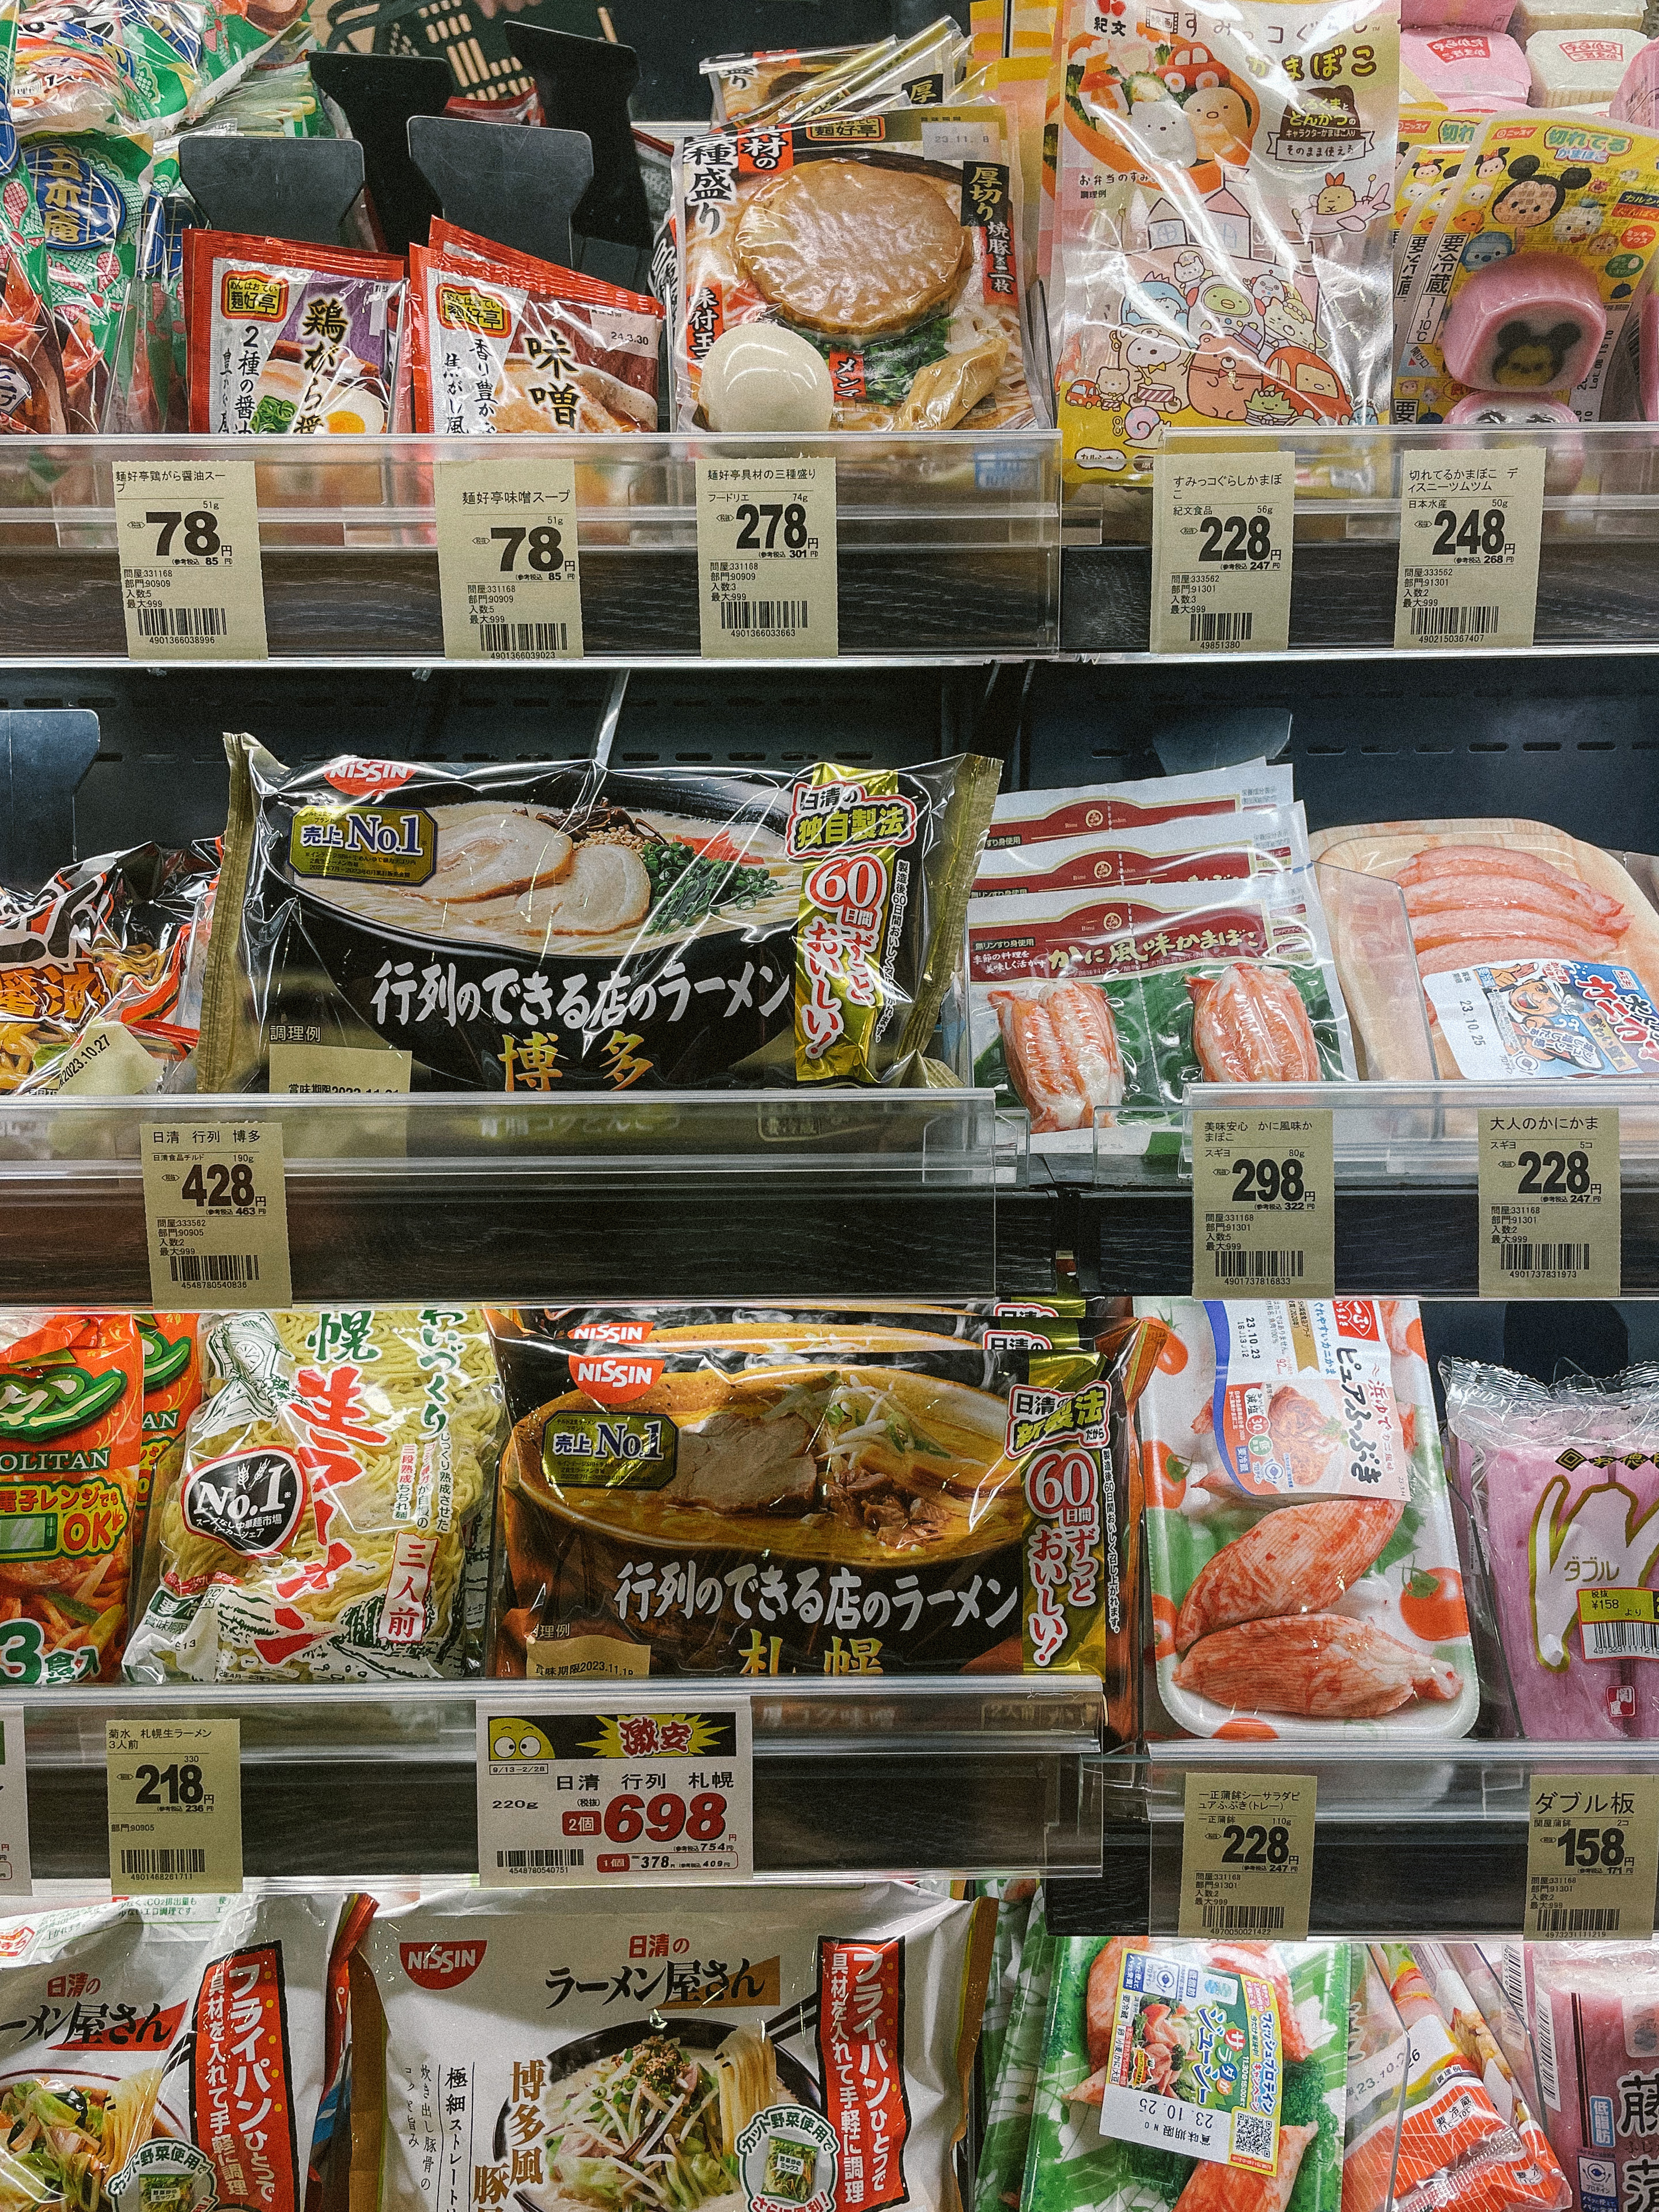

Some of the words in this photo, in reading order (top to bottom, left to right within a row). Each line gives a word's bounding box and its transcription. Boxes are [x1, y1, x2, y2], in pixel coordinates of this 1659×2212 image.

[1093, 16, 1126, 36] 紀文
[910, 80, 937, 103] 厚
[1290, 112, 1356, 127] とんかつの
[816, 124, 877, 137] 麺好亭
[1547, 128, 1627, 151] 切れてる
[1286, 145, 1354, 157] そのまま使える
[970, 165, 1003, 222] 厚切り
[1426, 235, 1464, 294] 要冷蔵
[230, 291, 276, 312] 麺好亭
[610, 332, 649, 346] 24.3.30
[524, 328, 580, 430] 味噌
[836, 356, 859, 398] メンマ
[116, 471, 226, 482] 麺好亭鶏がら醤油スー
[707, 469, 815, 480] 麺好亭具材の三種盛り
[1173, 474, 1282, 487] すみっコぐらしかまぼ
[1410, 468, 1497, 480] 切れてるかまぼこ
[1507, 468, 1518, 478] デ
[1173, 490, 1183, 499] こ
[1408, 481, 1492, 492] ィスニーツムツム
[203, 501, 219, 510] 51g
[462, 490, 570, 505] 麺好亭味噌スープ
[708, 494, 749, 502] フードリエ
[793, 493, 808, 502] 74g
[1409, 499, 1447, 509] 日本水産
[1492, 499, 1508, 508] 50g
[1173, 506, 1213, 516] 紀文食品
[1257, 505, 1273, 514] 56g
[547, 517, 563, 525] 51g
[730, 629, 796, 637] 4901366033663
[1419, 634, 1484, 643] 4902150367407
[491, 652, 555, 660] 4901366039023
[1200, 642, 1240, 650] 49851380
[329, 762, 408, 782] NISSIN
[800, 786, 858, 810] 日清の
[303, 825, 342, 844] 売上
[347, 815, 421, 854] No.1
[797, 806, 904, 849] 独自製法
[817, 858, 879, 908] 60
[844, 911, 873, 926] 日間
[975, 938, 1035, 950] 無リンすり身使用
[1048, 929, 1260, 971] かに風味かまぼこ
[972, 950, 1030, 965] 季節の料理を
[370, 959, 790, 1029] 行列のできる店のラーメン
[1459, 1000, 1486, 1046] 23.10.25
[270, 1025, 321, 1043] 調理例
[1205, 1122, 1248, 1131] 美味安心
[1258, 1122, 1312, 1131] かに風味か
[1490, 1116, 1598, 1131] 大人のかにかま
[153, 1131, 180, 1144] 日清
[192, 1130, 220, 1143] 行列
[233, 1130, 261, 1143] 博多
[1205, 1132, 1234, 1142] まぼこ
[1490, 1141, 1516, 1149] スギヨ
[233, 1154, 254, 1163] 190g
[1205, 1149, 1230, 1157] スギヨ
[1289, 1149, 1305, 1158] 80g
[575, 1325, 642, 1343] NISSIN
[1246, 1316, 1260, 1359] 23.10.23
[578, 1360, 653, 1388] NISSIN
[1368, 1379, 1392, 1429] 浜ゆで
[1016, 1386, 1107, 1449] 新製法
[1336, 1347, 1382, 1484] ピュアふぶき
[555, 1434, 592, 1455] 売上
[597, 1421, 664, 1459] No.1
[1085, 1427, 1105, 1441] だから
[194, 1463, 286, 1517] No.1
[1039, 1459, 1090, 1510] 60
[1066, 1511, 1092, 1523] 日間
[63, 1514, 113, 1550] OK
[1071, 1529, 1096, 1600] ずっと
[1564, 1556, 1620, 1582] ダブル
[387, 1543, 427, 1637] 三人前
[614, 1560, 1017, 1630] 行列のできる店のラーメン
[1592, 1590, 1609, 1598] 税抜
[1592, 1599, 1619, 1610] ¥158
[1624, 1608, 1642, 1616] より
[109, 1729, 131, 1739] 菊水
[141, 1728, 212, 1739] 札幌生ラーメン
[617, 1716, 692, 1756] 激安
[109, 1740, 139, 1749] 3人前
[557, 1774, 600, 1791] 日清
[622, 1772, 666, 1790] 行列
[688, 1771, 734, 1789] 札幌
[493, 1800, 539, 1809] 220g
[1199, 1790, 1300, 1801] 一正蒲鉾シーサラダピ
[1535, 1791, 1635, 1815] ダブル板
[569, 1817, 594, 1832] 2個
[1198, 1816, 1236, 1824] 一正蒲鉾
[1272, 1817, 1291, 1825] 110g
[1534, 1819, 1571, 1827] 関屋蒲鉾
[629, 1934, 690, 1959] 日清の
[408, 1946, 477, 1974] NISSIN
[47, 1972, 101, 1997] 日清の
[545, 1957, 766, 2009] ラーメン屋さん
[1195, 2008, 1213, 2104] ジューシー
[1261, 2012, 1278, 2115] フィッシュプロテイン
[207, 1967, 249, 2197] 具材を入れて手軽に調理
[830, 1953, 865, 2203] 具材を入れて手軽に調理
[853, 1953, 890, 2192] フライパンひとつで
[230, 1963, 275, 2203] フライパンひとつで
[1139, 2097, 1213, 2128] 23.10.25
[421, 2064, 437, 2191] 炊き出し豚骨の
[509, 2059, 547, 2187] 博多風
[743, 2112, 834, 2153] カット野菜使用で
[1163, 2124, 1211, 2146] 賞味期限
